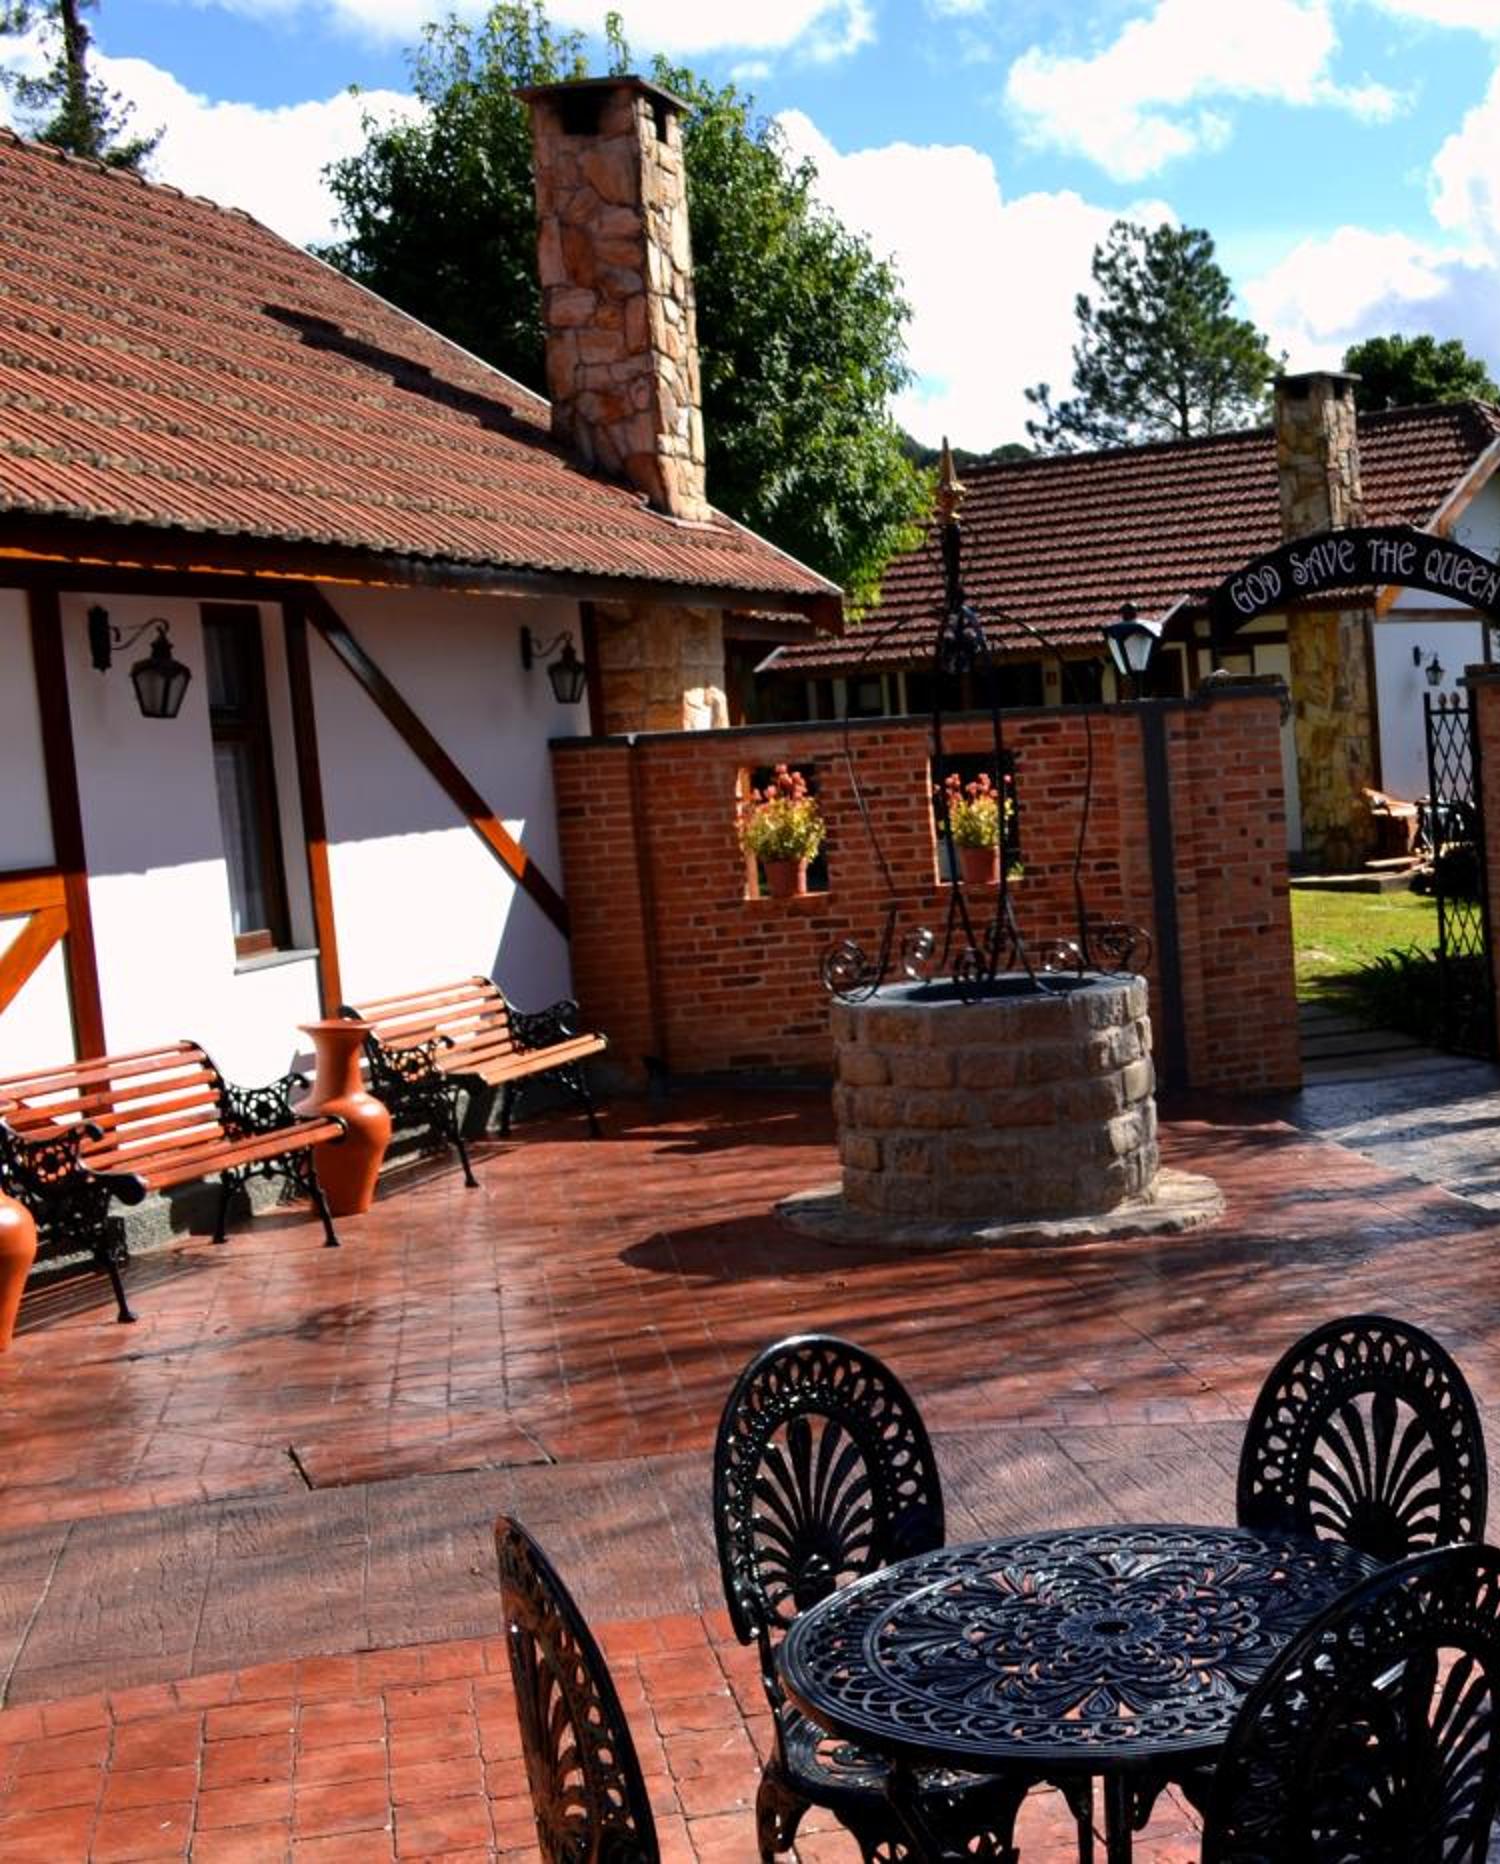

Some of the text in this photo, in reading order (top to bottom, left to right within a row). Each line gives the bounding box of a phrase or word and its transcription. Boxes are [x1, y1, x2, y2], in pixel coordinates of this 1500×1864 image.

[1230, 565, 1282, 614] GOD
[1289, 539, 1355, 586] SAVE
[1367, 539, 1417, 575] THE
